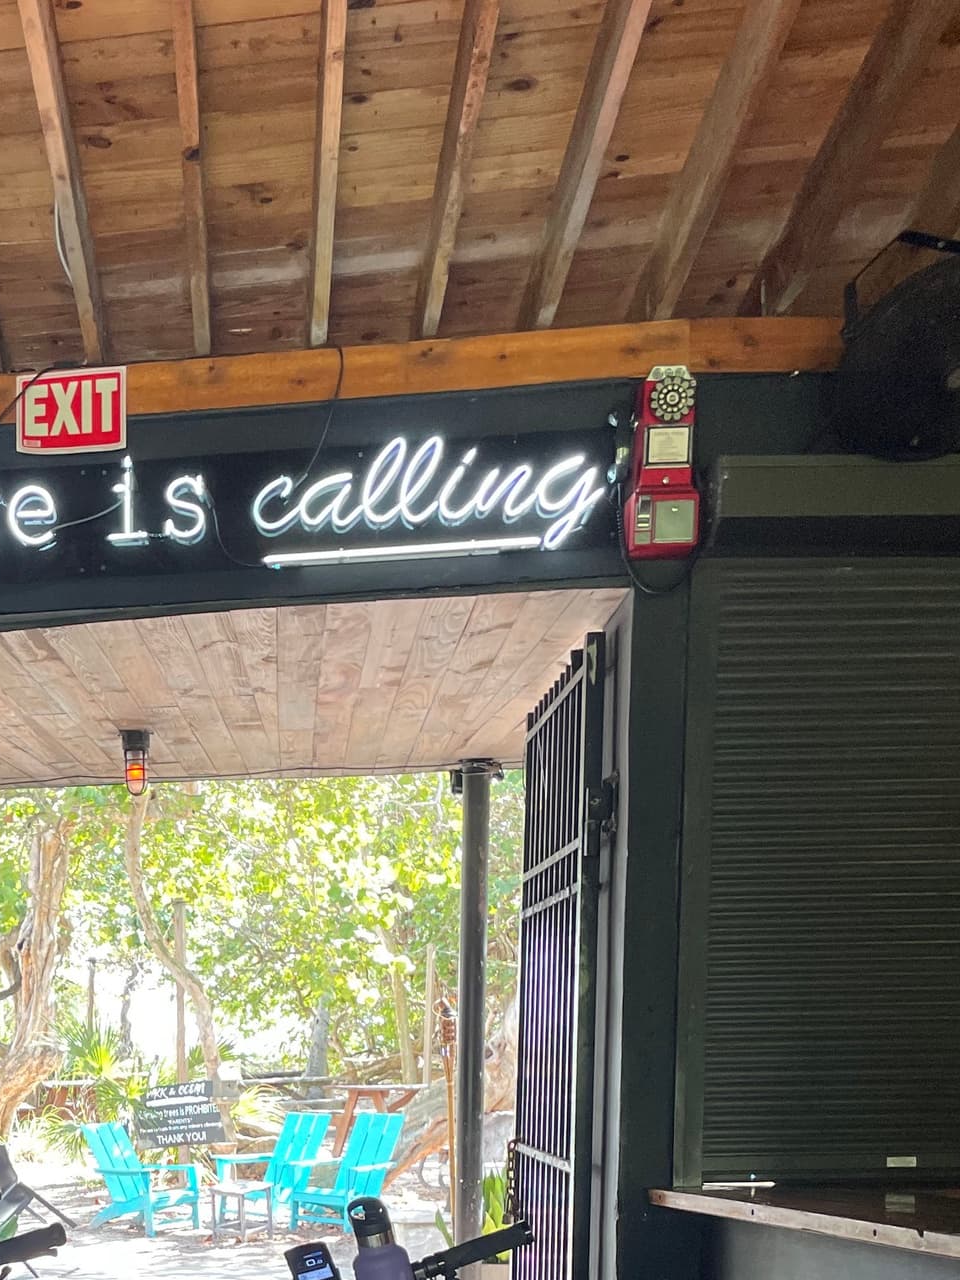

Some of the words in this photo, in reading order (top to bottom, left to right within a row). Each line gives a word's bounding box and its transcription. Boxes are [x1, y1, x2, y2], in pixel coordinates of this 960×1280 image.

[24, 376, 120, 438] EXIT
[106, 455, 207, 542] is
[253, 436, 605, 551] calling
[157, 1133, 184, 1144] THANK
